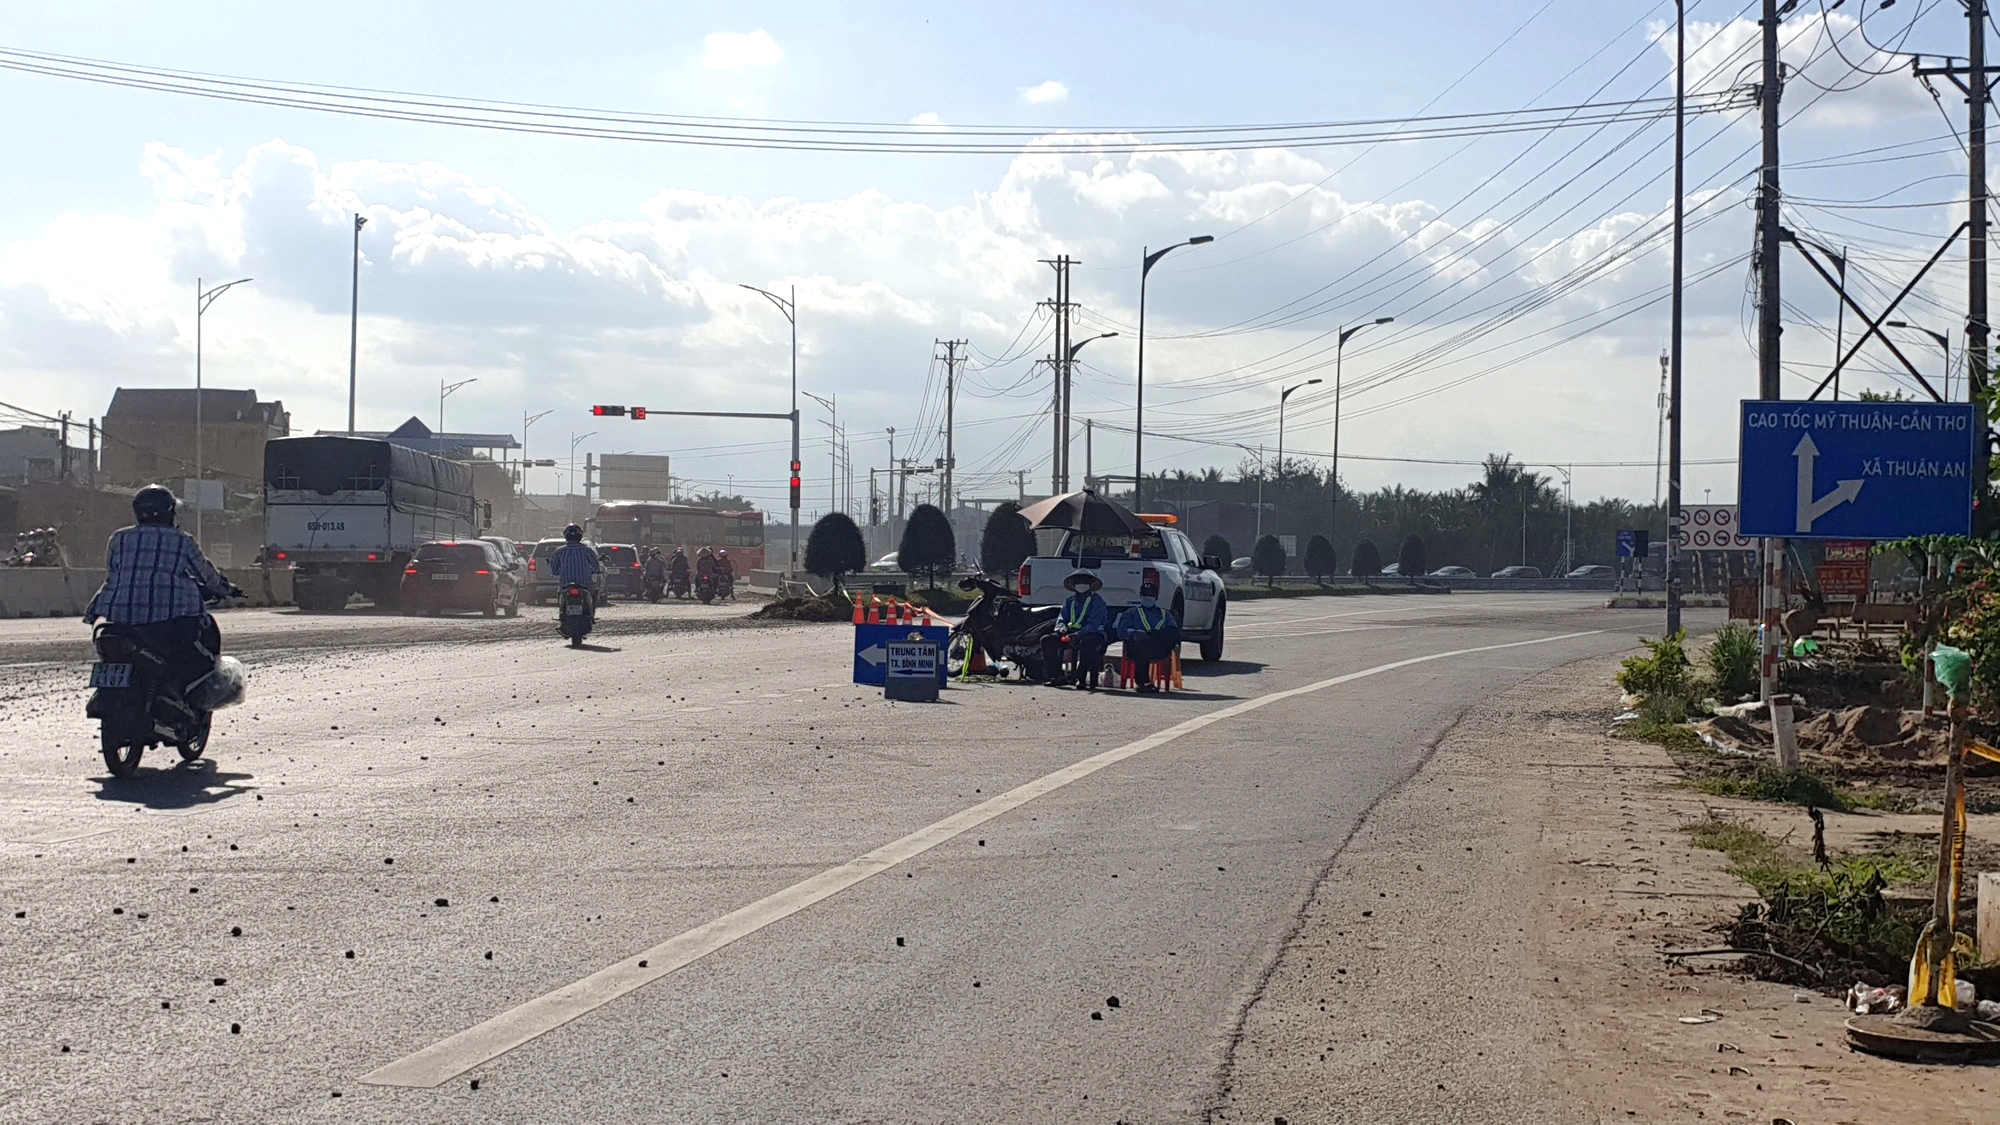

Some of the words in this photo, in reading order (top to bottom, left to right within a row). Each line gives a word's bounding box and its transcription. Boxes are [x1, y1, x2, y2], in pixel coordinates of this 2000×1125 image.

[1748, 412, 1778, 428] CAO
[1781, 407, 1811, 429] TỐC
[1814, 411, 1836, 429] MỸ
[1935, 414, 1967, 431] THƠ
[1861, 457, 1882, 476] XÃ
[1886, 458, 1939, 479] THUẬN
[1943, 462, 1965, 477] AN
[890, 646, 916, 656] TRUNG
[918, 645, 935, 656] TÂM
[917, 660, 934, 668] MINH
